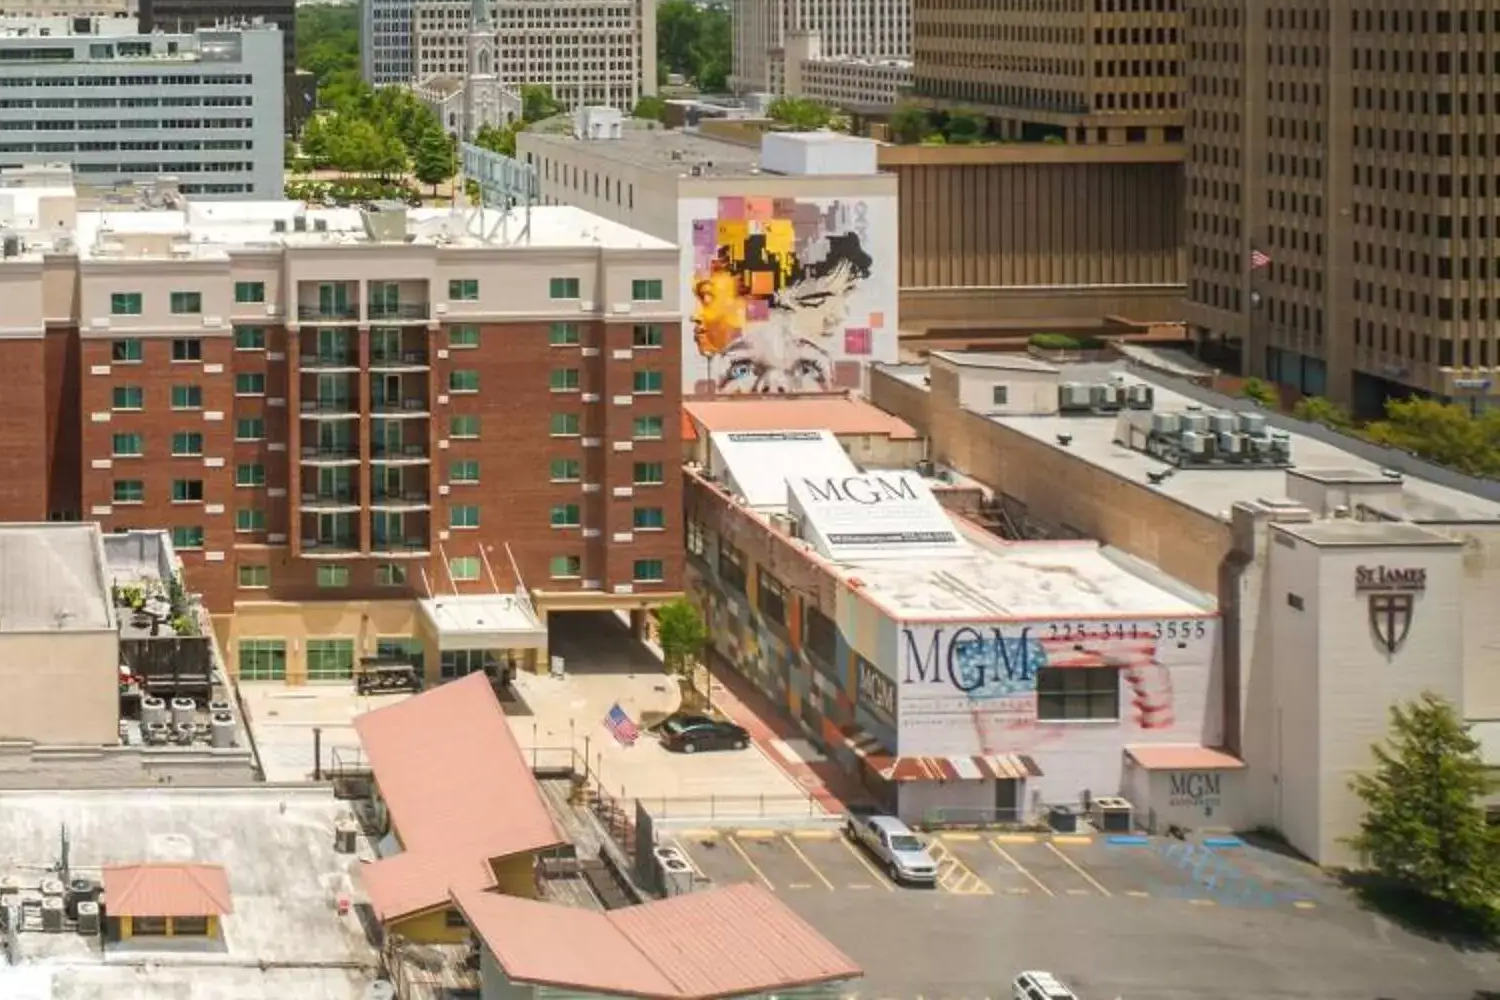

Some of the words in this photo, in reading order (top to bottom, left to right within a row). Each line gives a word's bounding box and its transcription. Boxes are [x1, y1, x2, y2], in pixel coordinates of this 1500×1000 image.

[802, 476, 918, 505] MGM
[902, 626, 1033, 693] MGM
[1170, 773, 1221, 799] MGM
